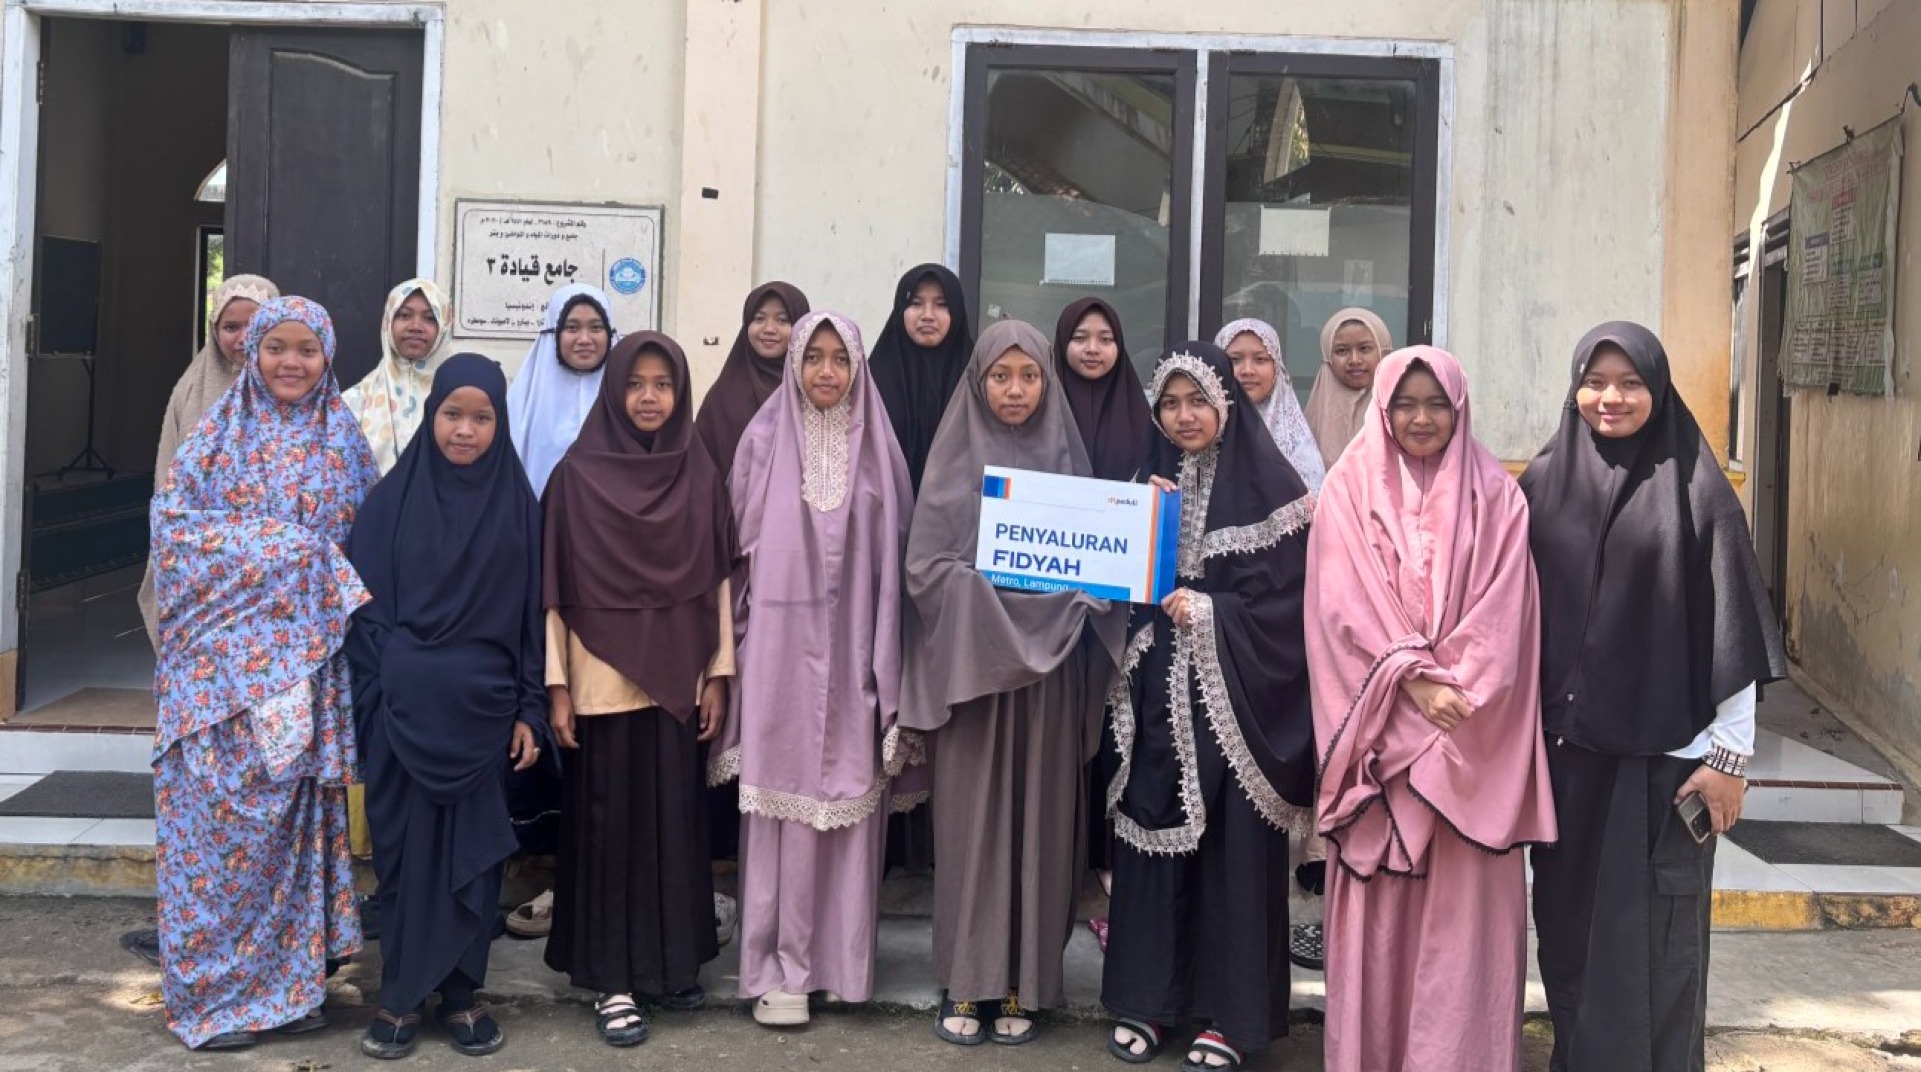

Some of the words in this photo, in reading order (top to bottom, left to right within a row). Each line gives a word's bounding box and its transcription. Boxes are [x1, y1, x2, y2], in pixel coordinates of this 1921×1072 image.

[486, 257, 496, 277] ٣
[500, 254, 540, 283] قيادة
[544, 258, 579, 286] جامع
[995, 522, 1128, 555] PENYALURAN
[992, 549, 1081, 576] FIDYAH
[991, 573, 1021, 588] Metro,
